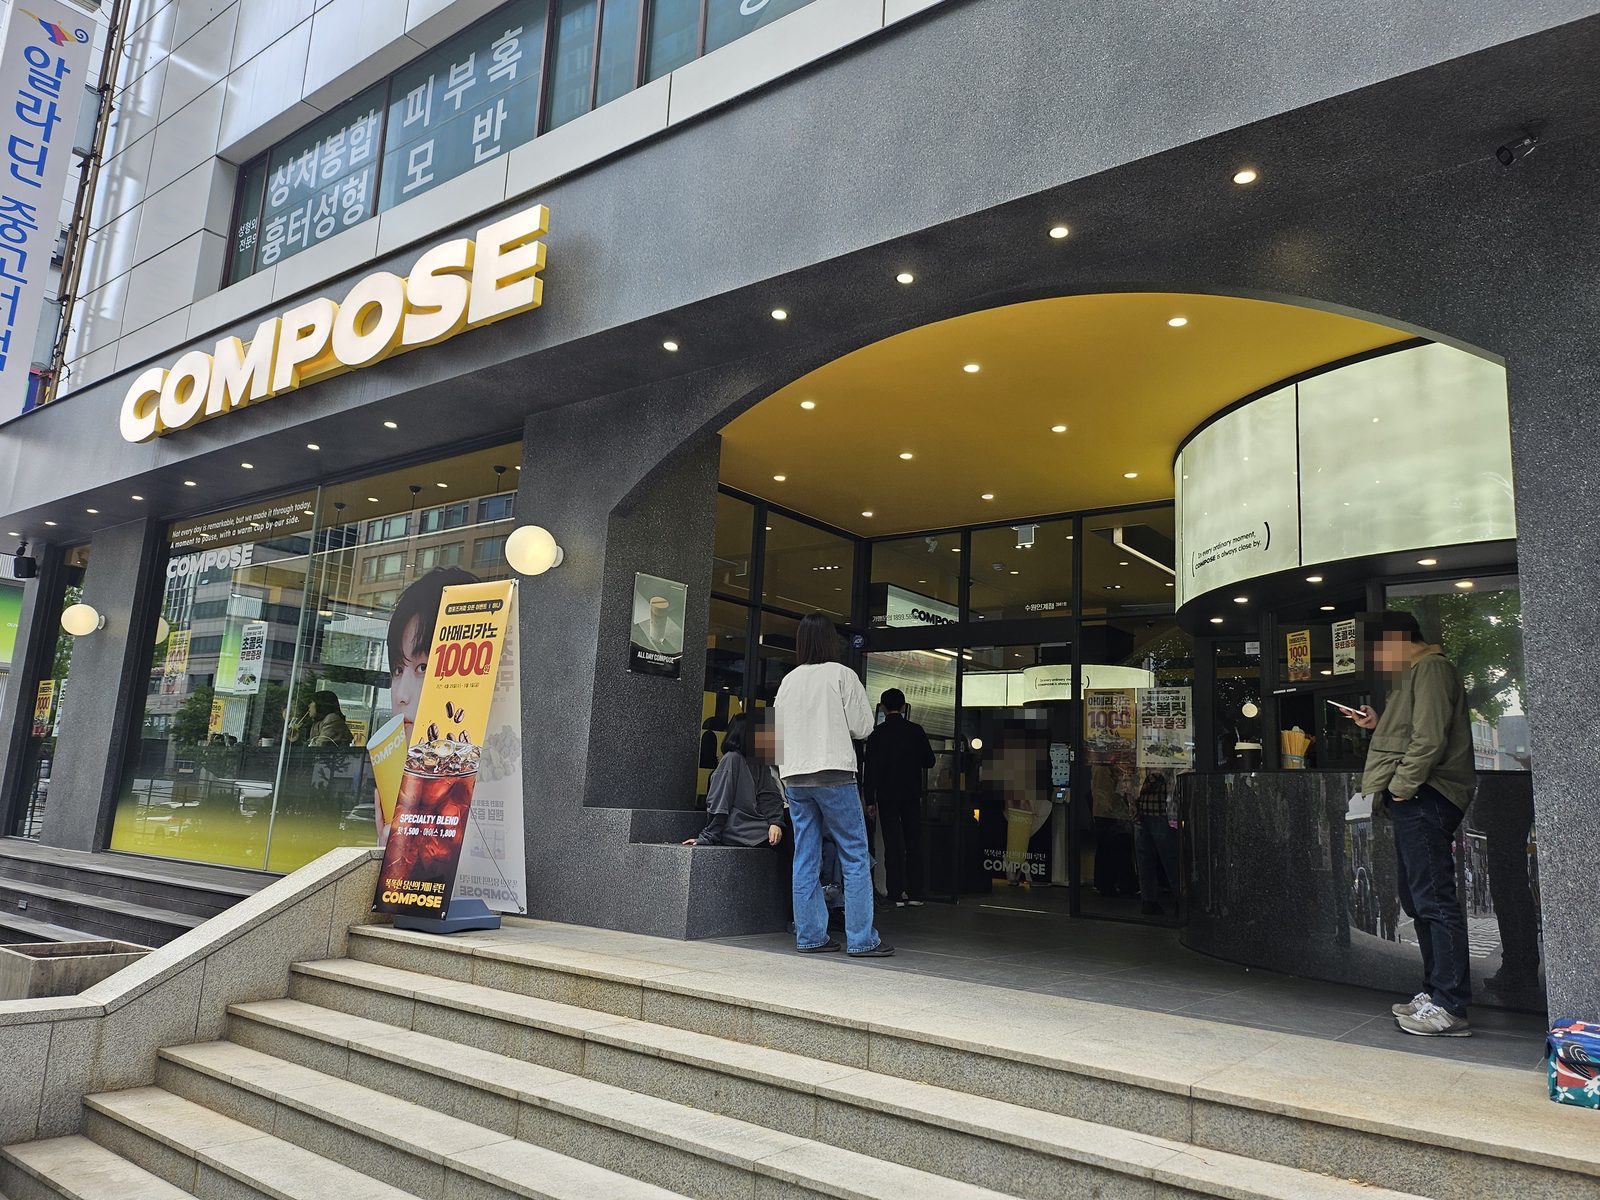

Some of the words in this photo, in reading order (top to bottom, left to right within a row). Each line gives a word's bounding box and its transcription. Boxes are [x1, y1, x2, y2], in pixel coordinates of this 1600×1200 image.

[7, 45, 71, 190] 알라딘
[270, 108, 377, 208] 상처봉합
[261, 169, 369, 265] 흉터성형
[119, 203, 549, 443] COMPOSE
[180, 528, 193, 537] every
[193, 525, 203, 534] day
[244, 514, 253, 522] we
[252, 510, 268, 520] made
[272, 503, 294, 516] through
[294, 500, 312, 511] today.
[174, 538, 195, 549] moment
[219, 529, 232, 539] with
[237, 526, 253, 535] warm
[253, 523, 265, 533] cup
[265, 520, 274, 531] by
[273, 519, 286, 528] our
[285, 515, 300, 525] side.
[1194, 554, 1216, 570] COMPOSE
[1220, 546, 1238, 559] always
[1238, 542, 1252, 552] close
[1252, 539, 1262, 549] by.
[1212, 539, 1232, 552] ordinary
[166, 543, 254, 579] COMPOSE
[439, 622, 498, 642] 아메리카노
[636, 650, 646, 659] ALL
[645, 652, 654, 660] DAY
[1141, 701, 1187, 717] 초콜릿
[399, 813, 437, 825] SPECIALTY
[436, 815, 459, 826] BLEND
[403, 827, 420, 837] 1,500
[983, 859, 1046, 876] COMPOSE
[402, 879, 421, 891] 당신의
[382, 890, 443, 909] COMPOSE
